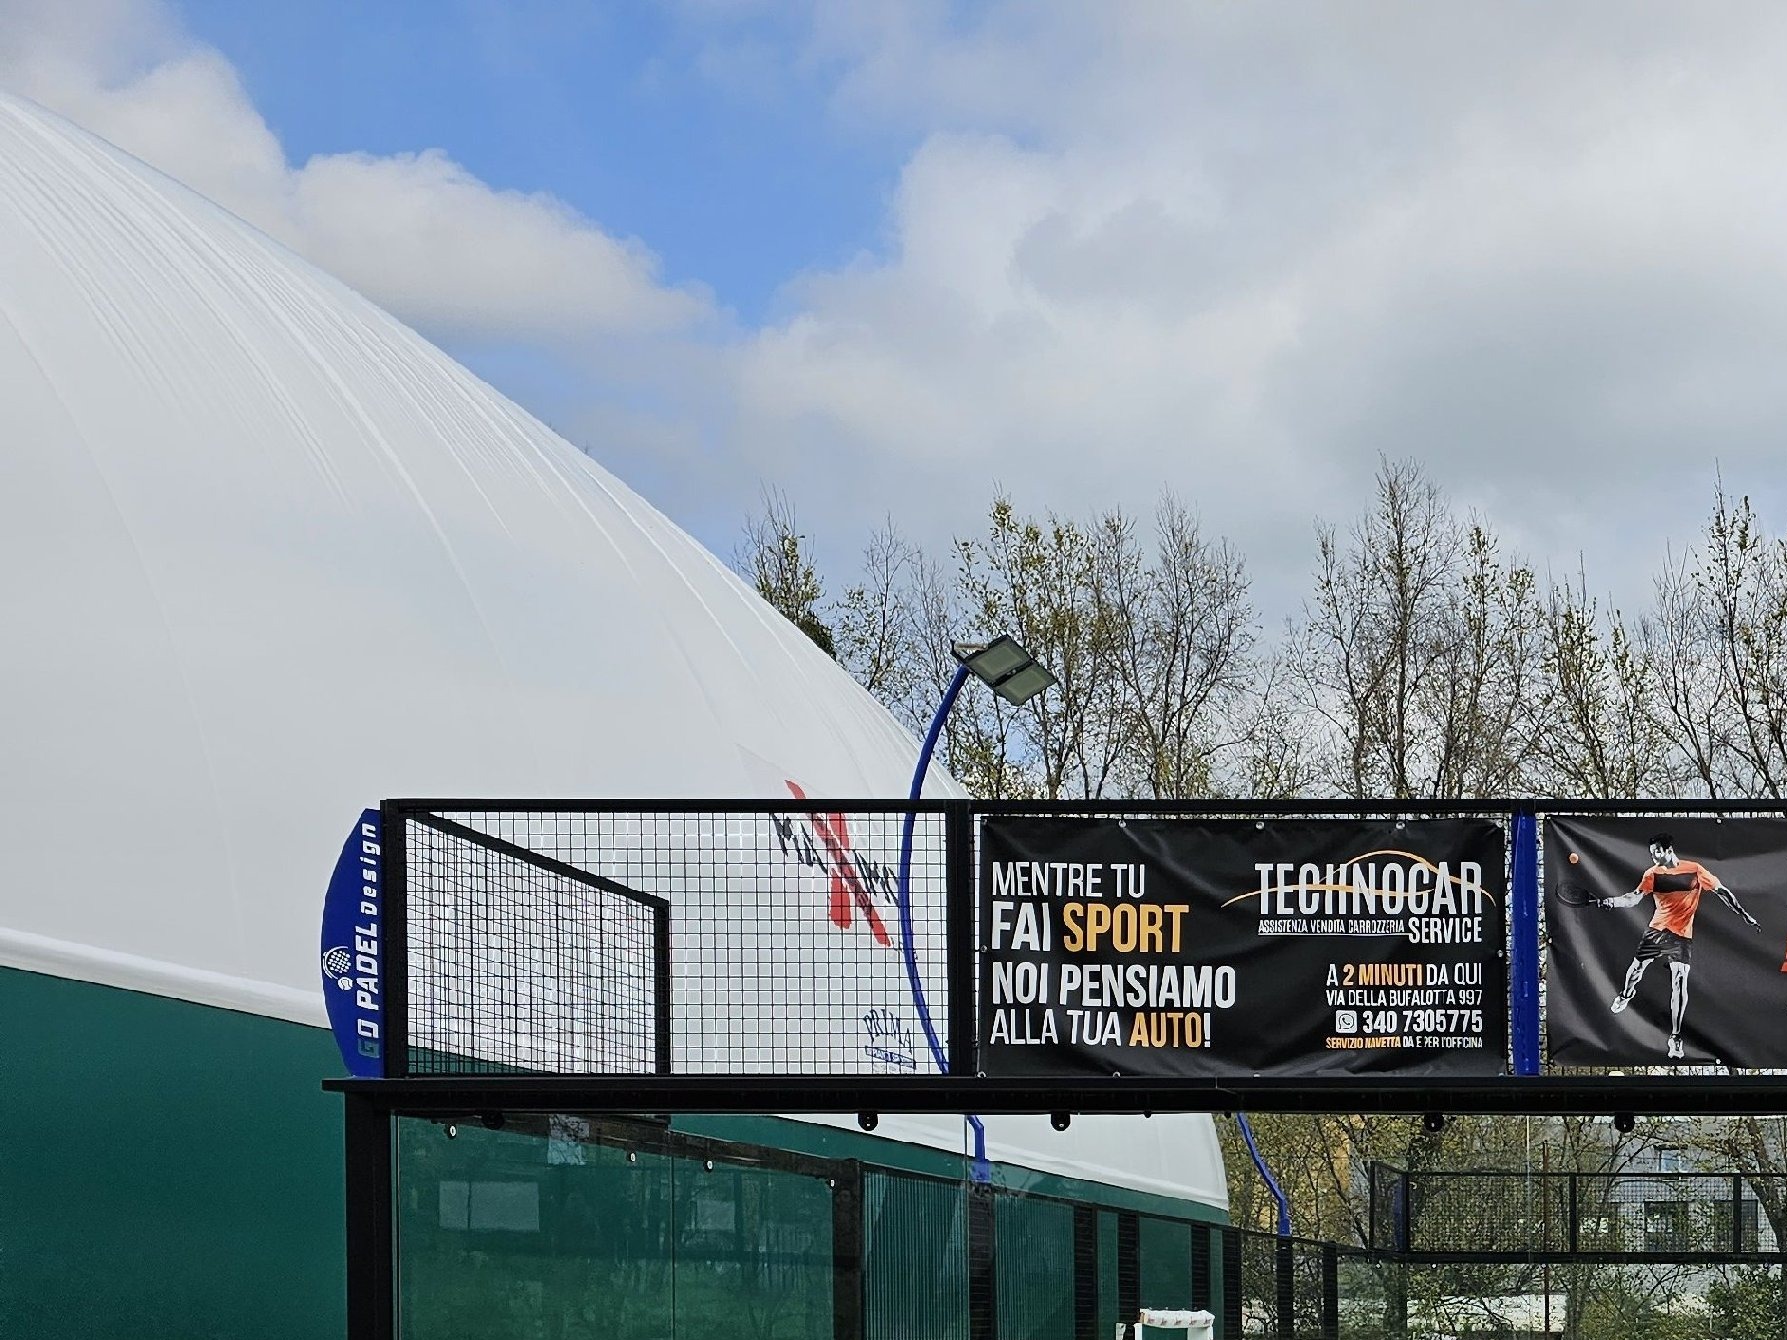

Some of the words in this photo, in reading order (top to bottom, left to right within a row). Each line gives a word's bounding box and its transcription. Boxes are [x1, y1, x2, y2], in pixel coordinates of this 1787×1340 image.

[992, 861, 1103, 897] MENTRE
[1111, 863, 1145, 898] TU
[1255, 861, 1482, 915] TECHNOCAR
[991, 901, 1051, 952] FAI
[1063, 902, 1190, 953] SPORT
[1258, 919, 1308, 934] ASSISTENZA
[1310, 919, 1345, 934] VENDITA
[1348, 919, 1404, 934] CARROZZERIA
[1408, 917, 1482, 944] SERVICE
[355, 923, 379, 1010] PADEL
[992, 962, 1049, 1004] NOI
[1059, 963, 1236, 1008] PENSIAMO
[1326, 963, 1339, 986] A
[1342, 963, 1355, 986] 2
[1358, 963, 1423, 986] MINUTI
[1426, 963, 1449, 986] DA
[1454, 962, 1482, 986] QUI
[1325, 989, 1345, 1006] VIA
[1348, 989, 1387, 1006] DELLA
[1390, 989, 1456, 1006] BUFALOTTA
[1459, 989, 1483, 1006] 997
[358, 1019, 379, 1058] GO
[990, 1008, 1058, 1045] ALLA
[1067, 1009, 1121, 1046] TUA
[1129, 1012, 1211, 1048] AUTO!
[1362, 1010, 1397, 1034] 340
[1403, 1009, 1483, 1033] 7305775
[1325, 1037, 1364, 1049] SERVIZIO
[1365, 1037, 1401, 1048] NAVETTA
[1403, 1036, 1414, 1048] DA
